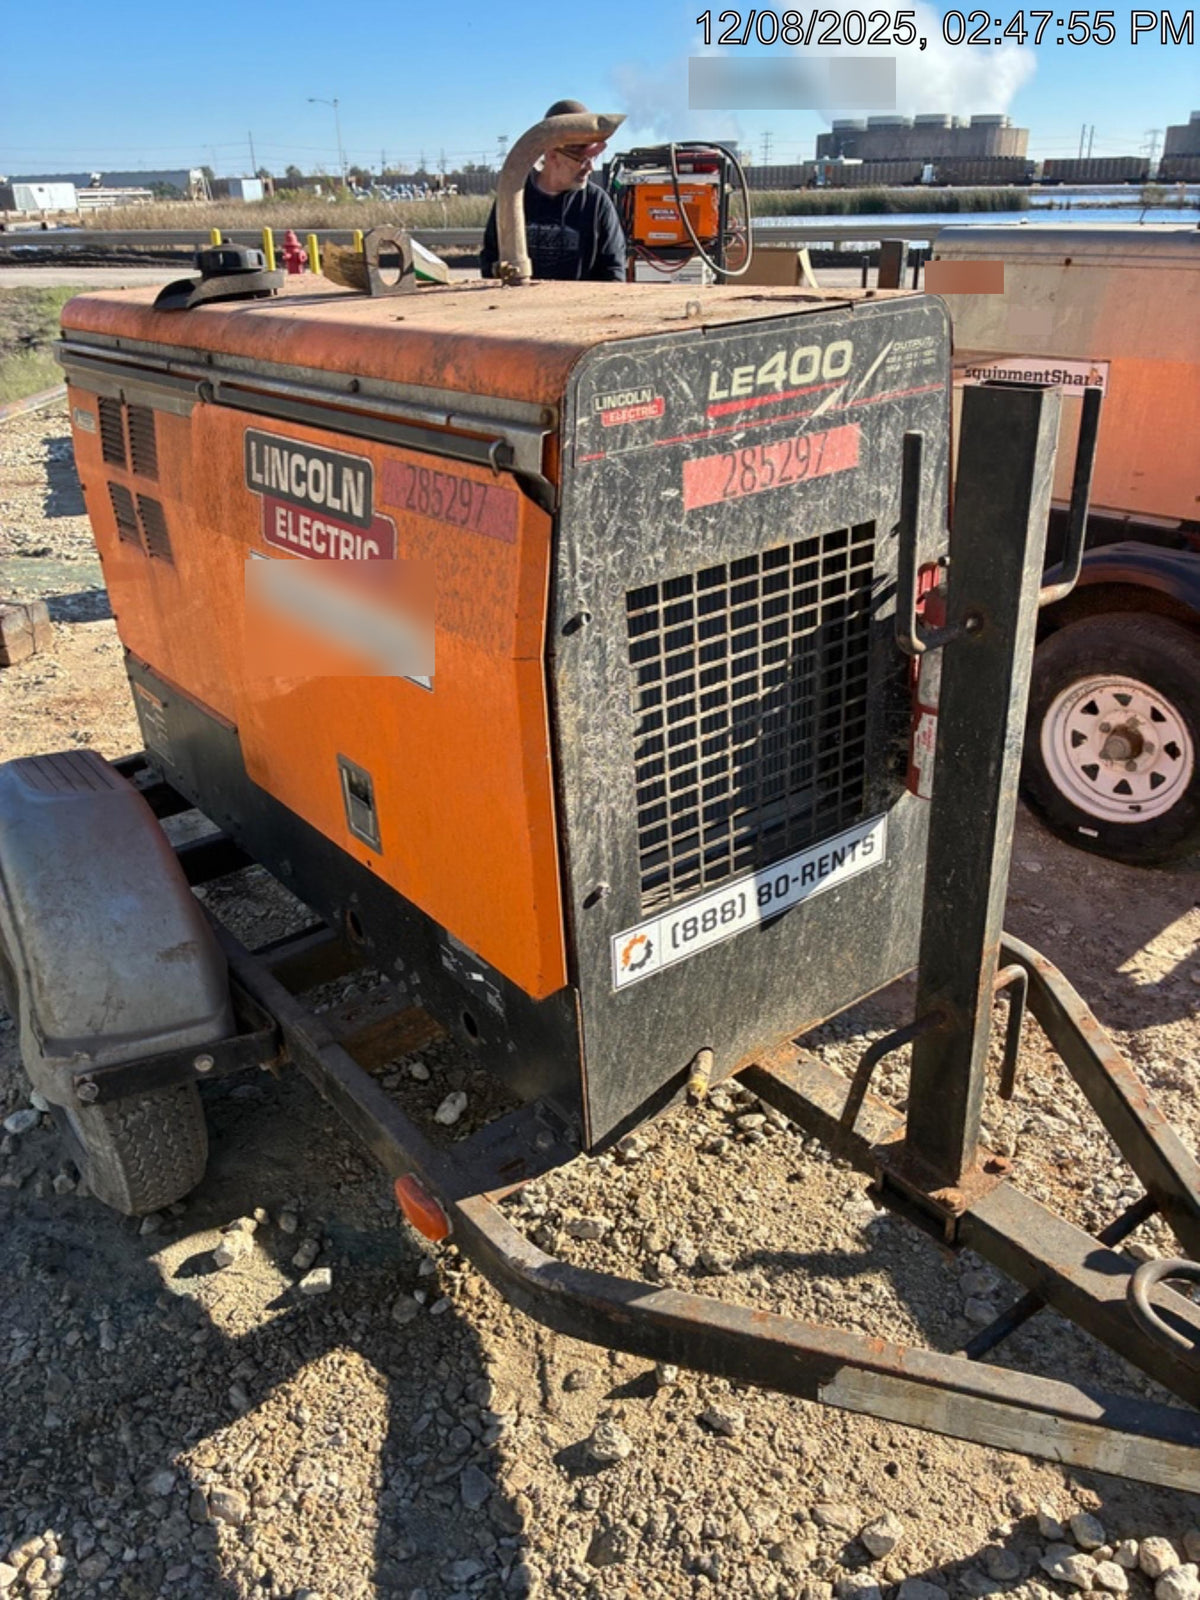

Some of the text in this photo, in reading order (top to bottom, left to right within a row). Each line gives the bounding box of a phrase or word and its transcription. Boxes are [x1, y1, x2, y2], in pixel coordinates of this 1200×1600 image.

[594, 388, 652, 411] LINCOLN
[708, 339, 854, 401] LE400
[609, 404, 659, 422] ELECTRIC
[251, 440, 365, 518] LINCOLN
[406, 464, 488, 528] 285297
[722, 432, 829, 498] 285297
[275, 506, 380, 560] ELECTRIC
[671, 833, 875, 950] (888) 80-RENTS
